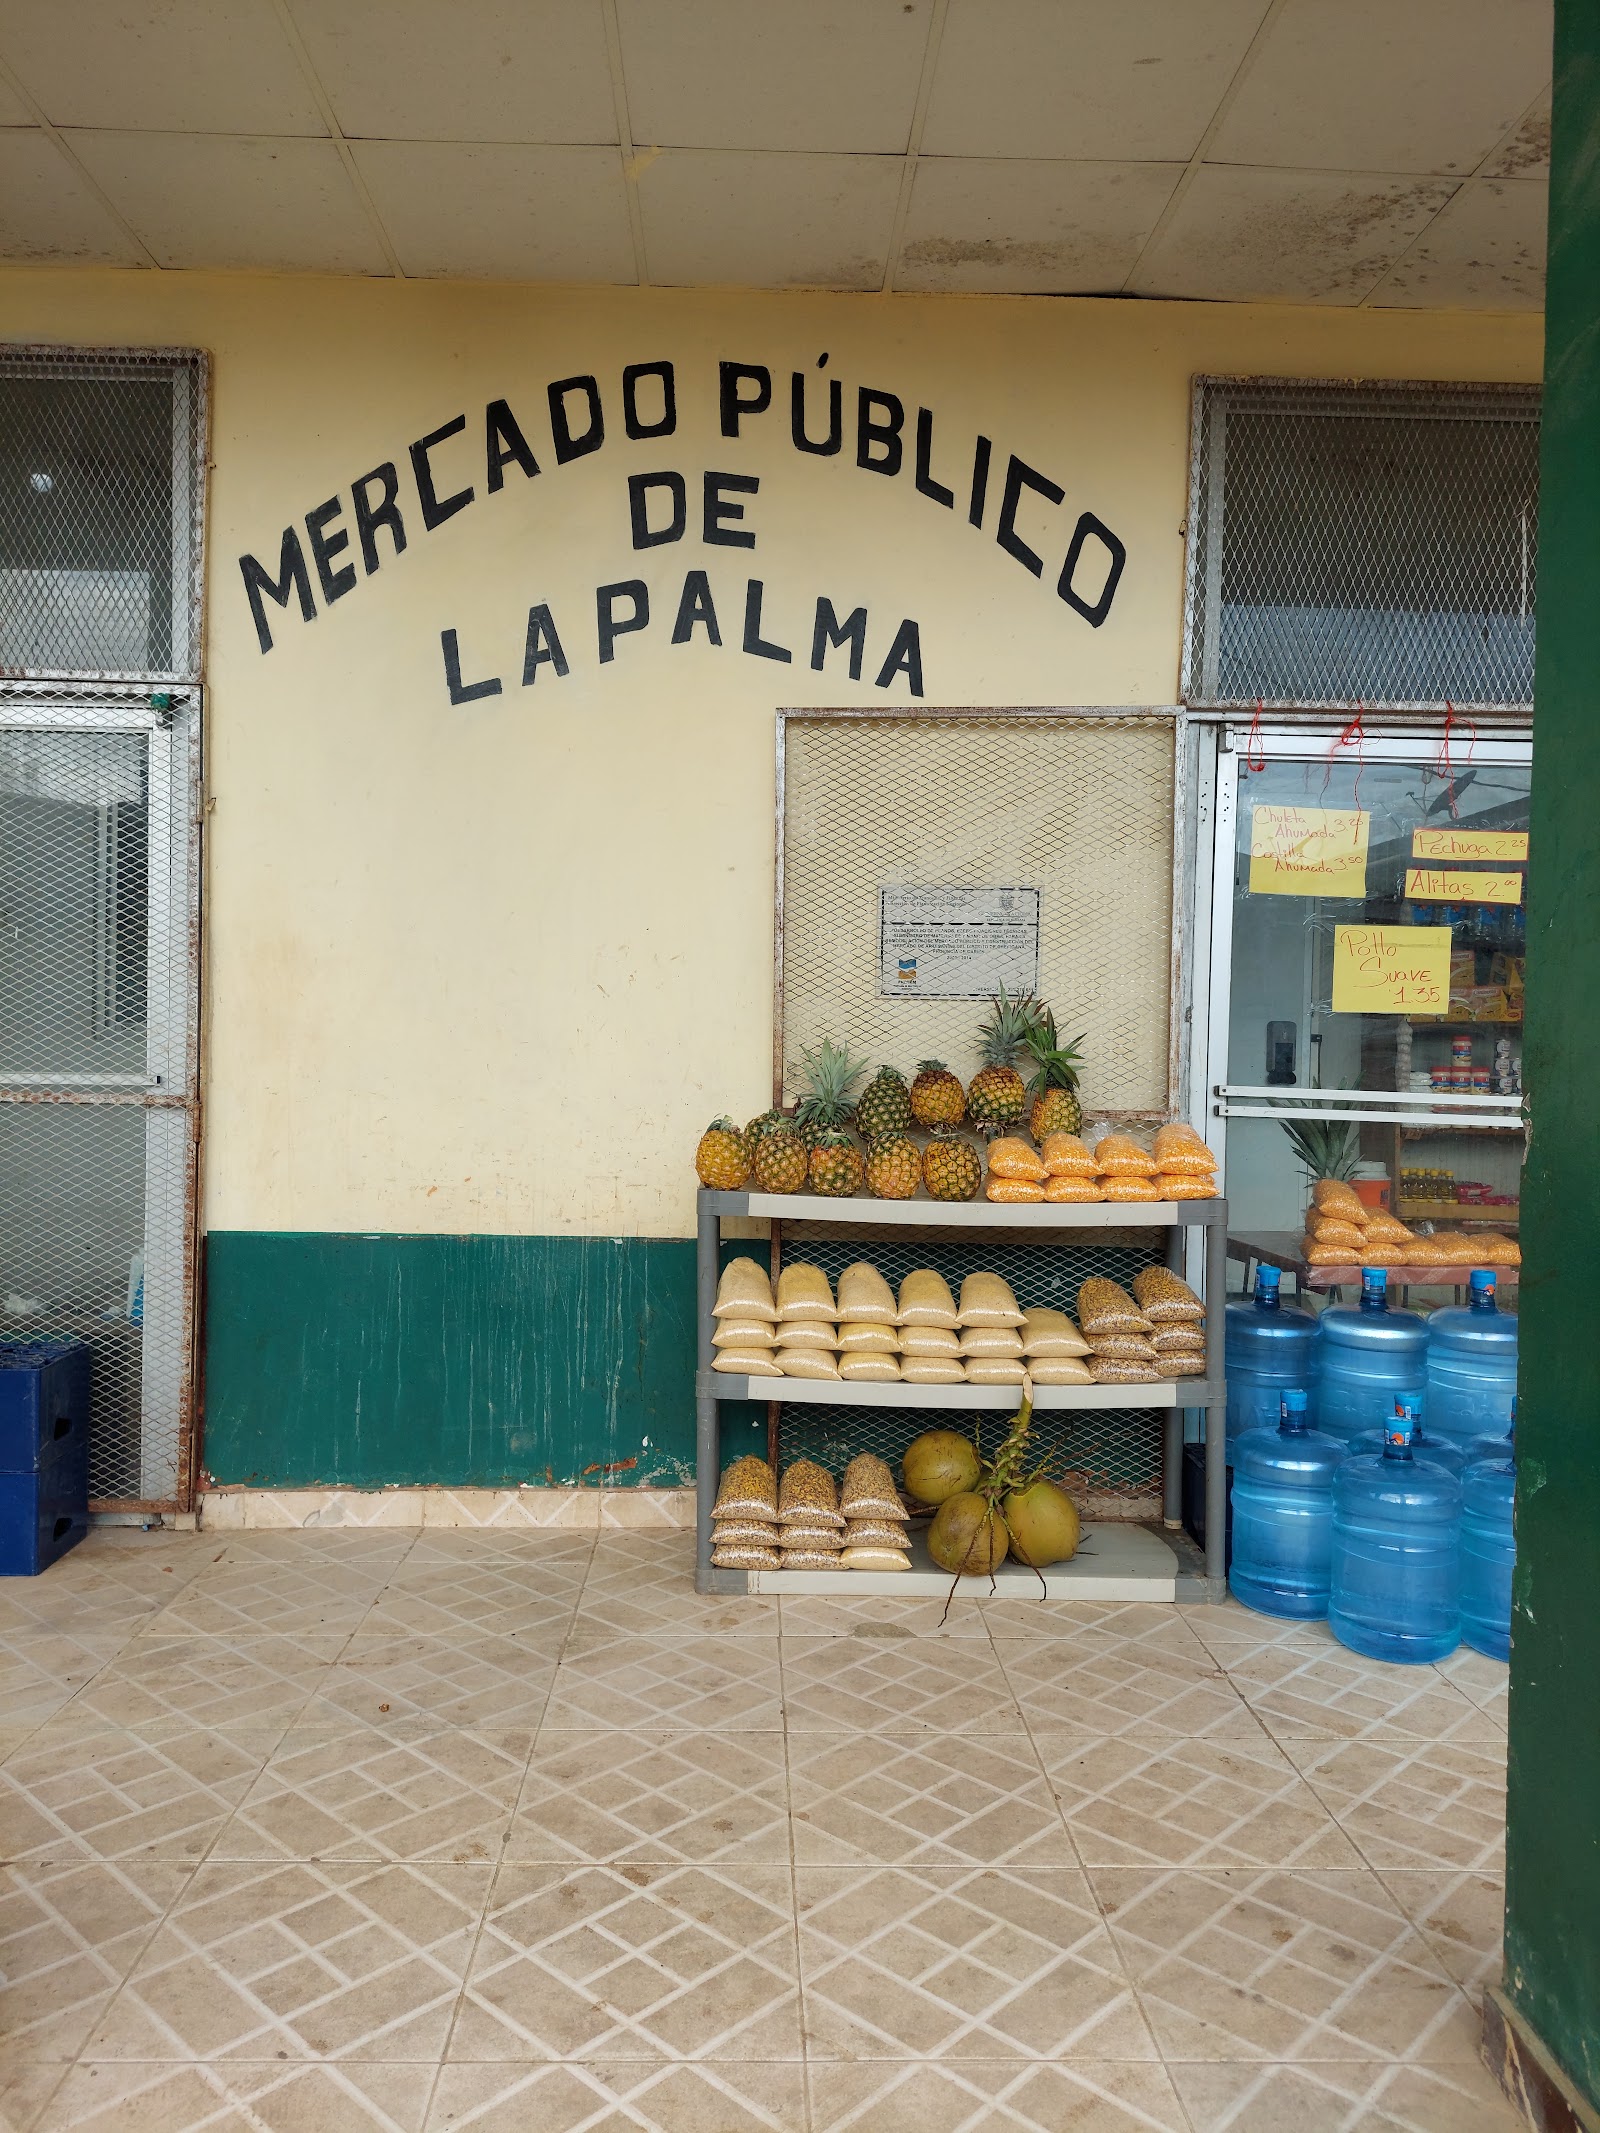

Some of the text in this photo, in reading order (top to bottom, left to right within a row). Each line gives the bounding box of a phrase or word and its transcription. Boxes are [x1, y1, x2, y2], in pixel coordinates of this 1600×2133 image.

[238, 351, 1127, 655] MERCADO PÚBLICO
[627, 470, 760, 551] DE
[441, 570, 924, 706] LA PALMA
[1275, 824, 1336, 839] Ahumada
[1251, 842, 1306, 859] Costilla
[1274, 858, 1334, 874] Ahumada
[1410, 870, 1474, 896] Alitas
[1340, 929, 1397, 957] Pollo
